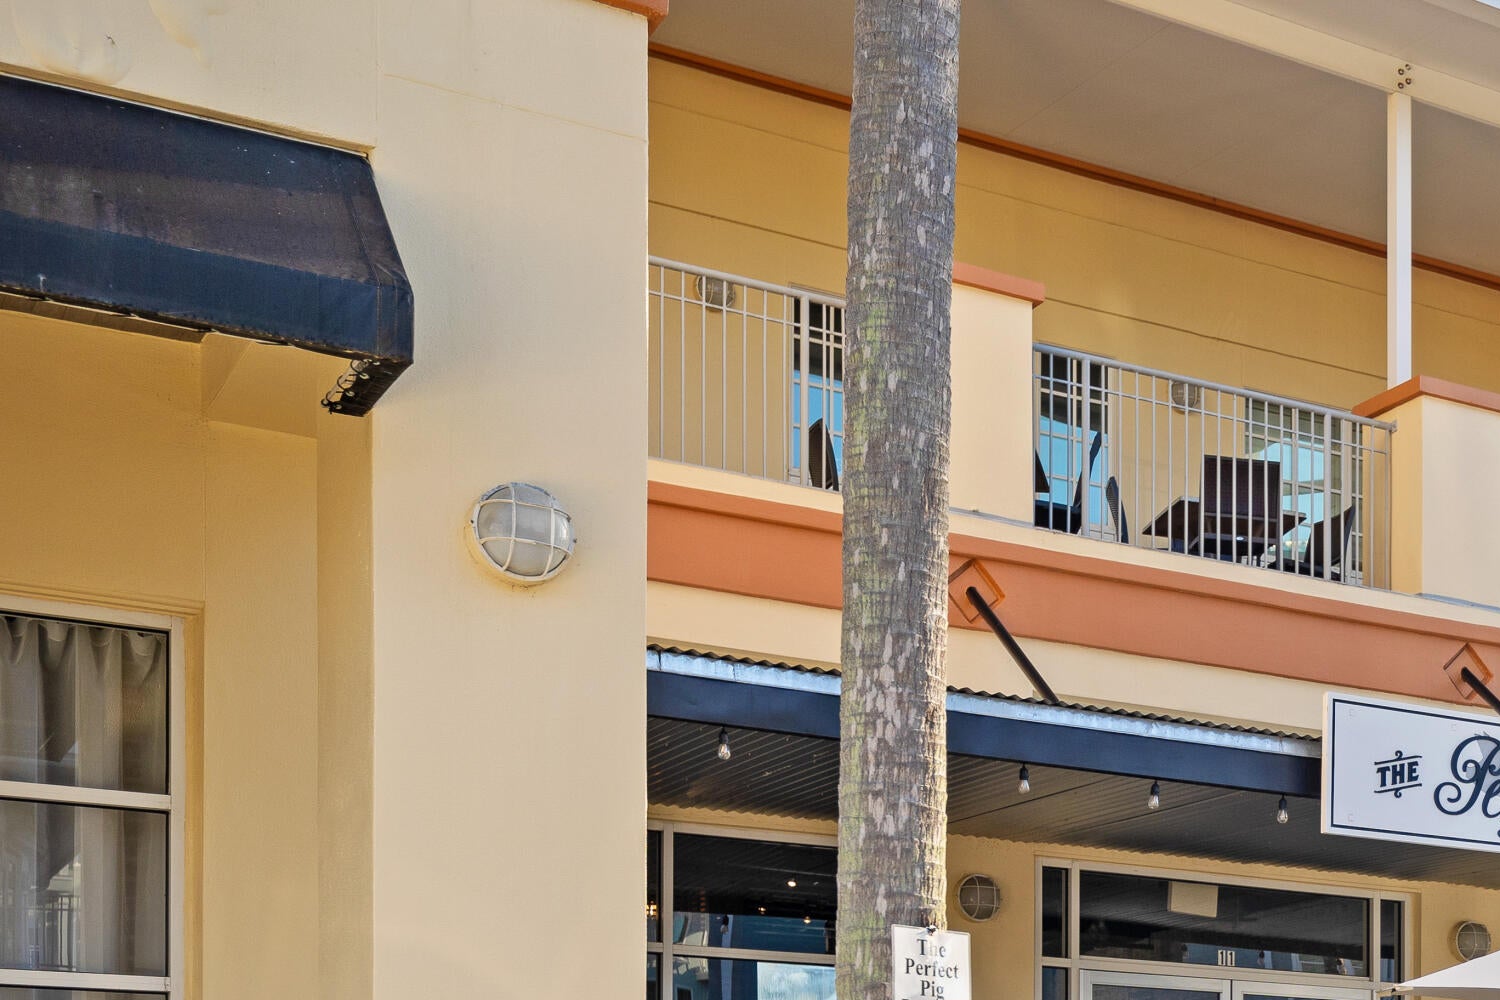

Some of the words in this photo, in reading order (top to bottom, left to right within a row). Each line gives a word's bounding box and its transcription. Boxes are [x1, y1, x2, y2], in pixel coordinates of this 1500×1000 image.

[1376, 761, 1420, 789] THE
[917, 939, 946, 957] The
[1219, 950, 1234, 966] 11
[905, 958, 960, 979] Perfect
